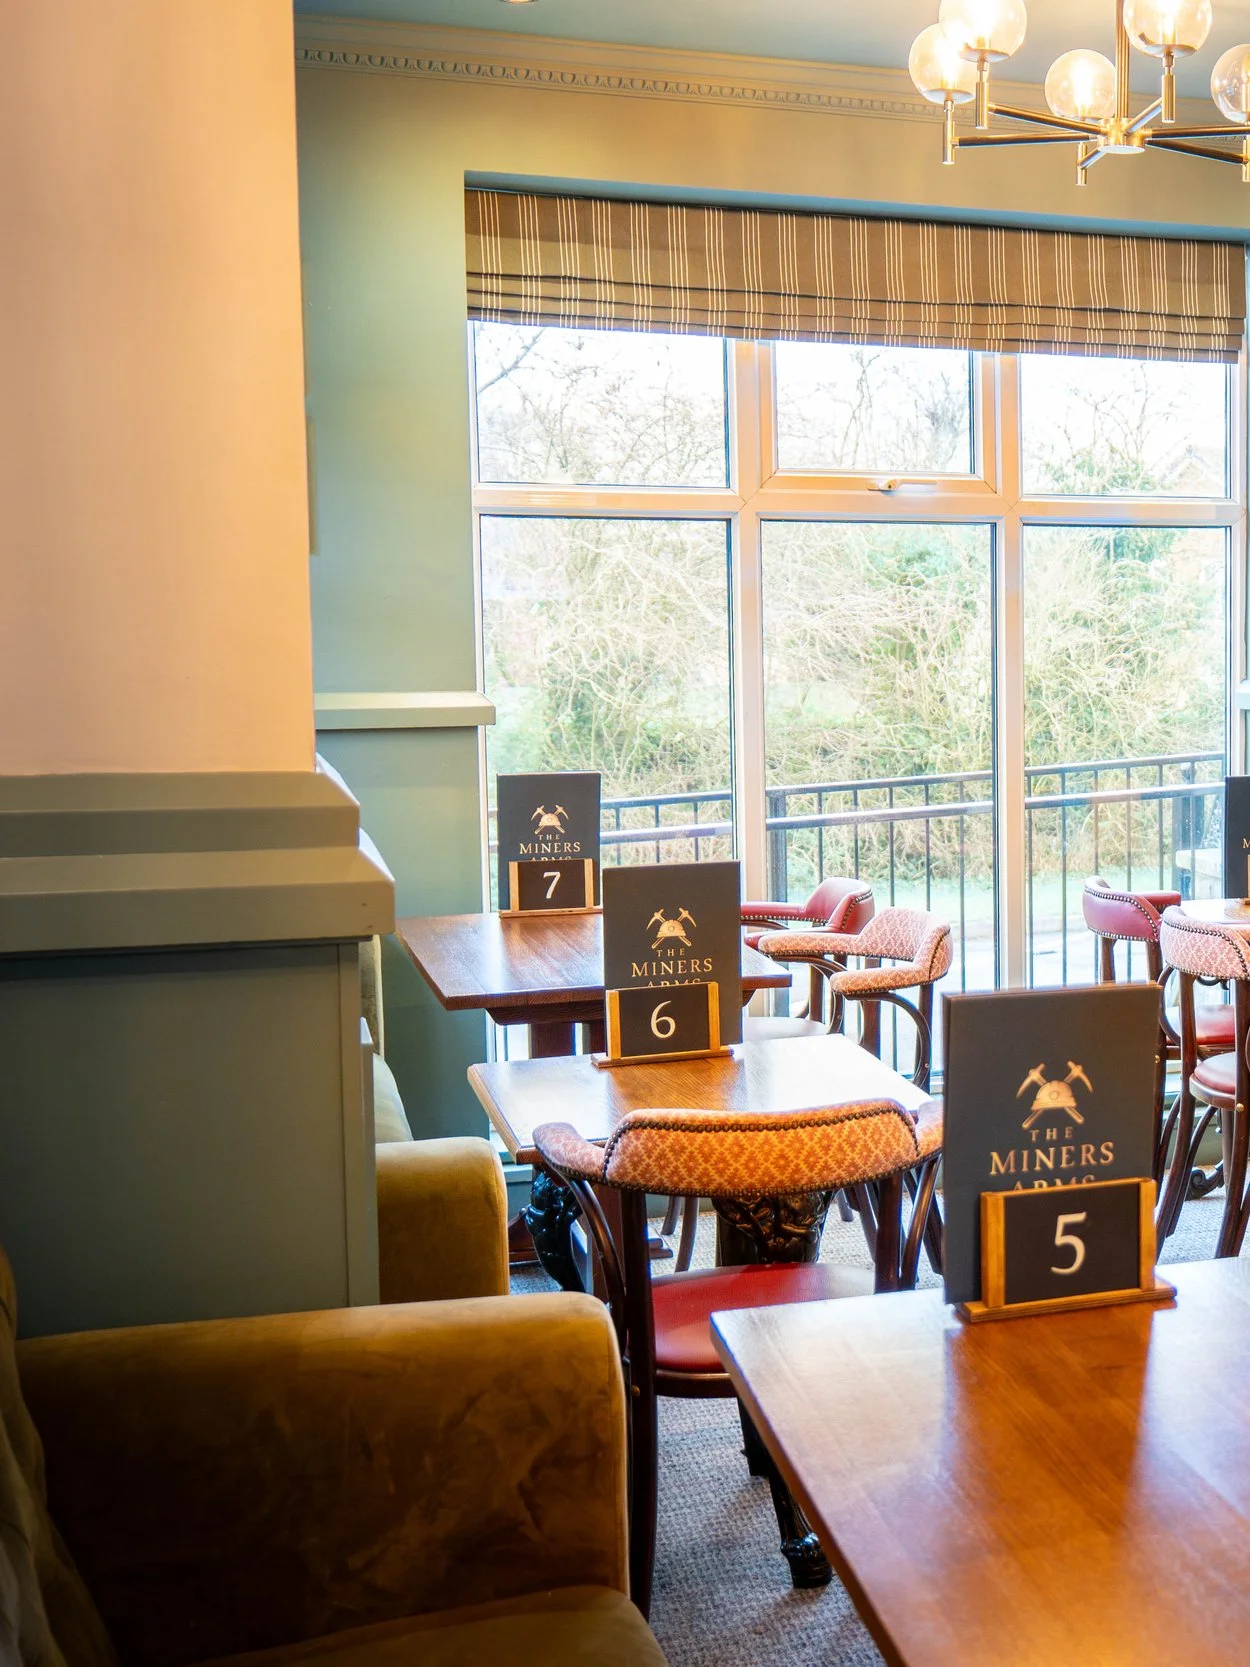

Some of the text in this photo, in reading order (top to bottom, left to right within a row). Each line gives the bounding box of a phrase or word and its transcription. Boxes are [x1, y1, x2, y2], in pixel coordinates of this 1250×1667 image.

[519, 841, 581, 855] MINERS
[543, 871, 561, 899] 7
[656, 948, 685, 958] THE
[631, 958, 713, 978] MINERS
[651, 1001, 676, 1038] 6
[1029, 1126, 1074, 1142] THE
[989, 1141, 1115, 1176] MINERS
[1051, 1211, 1087, 1275] 5
